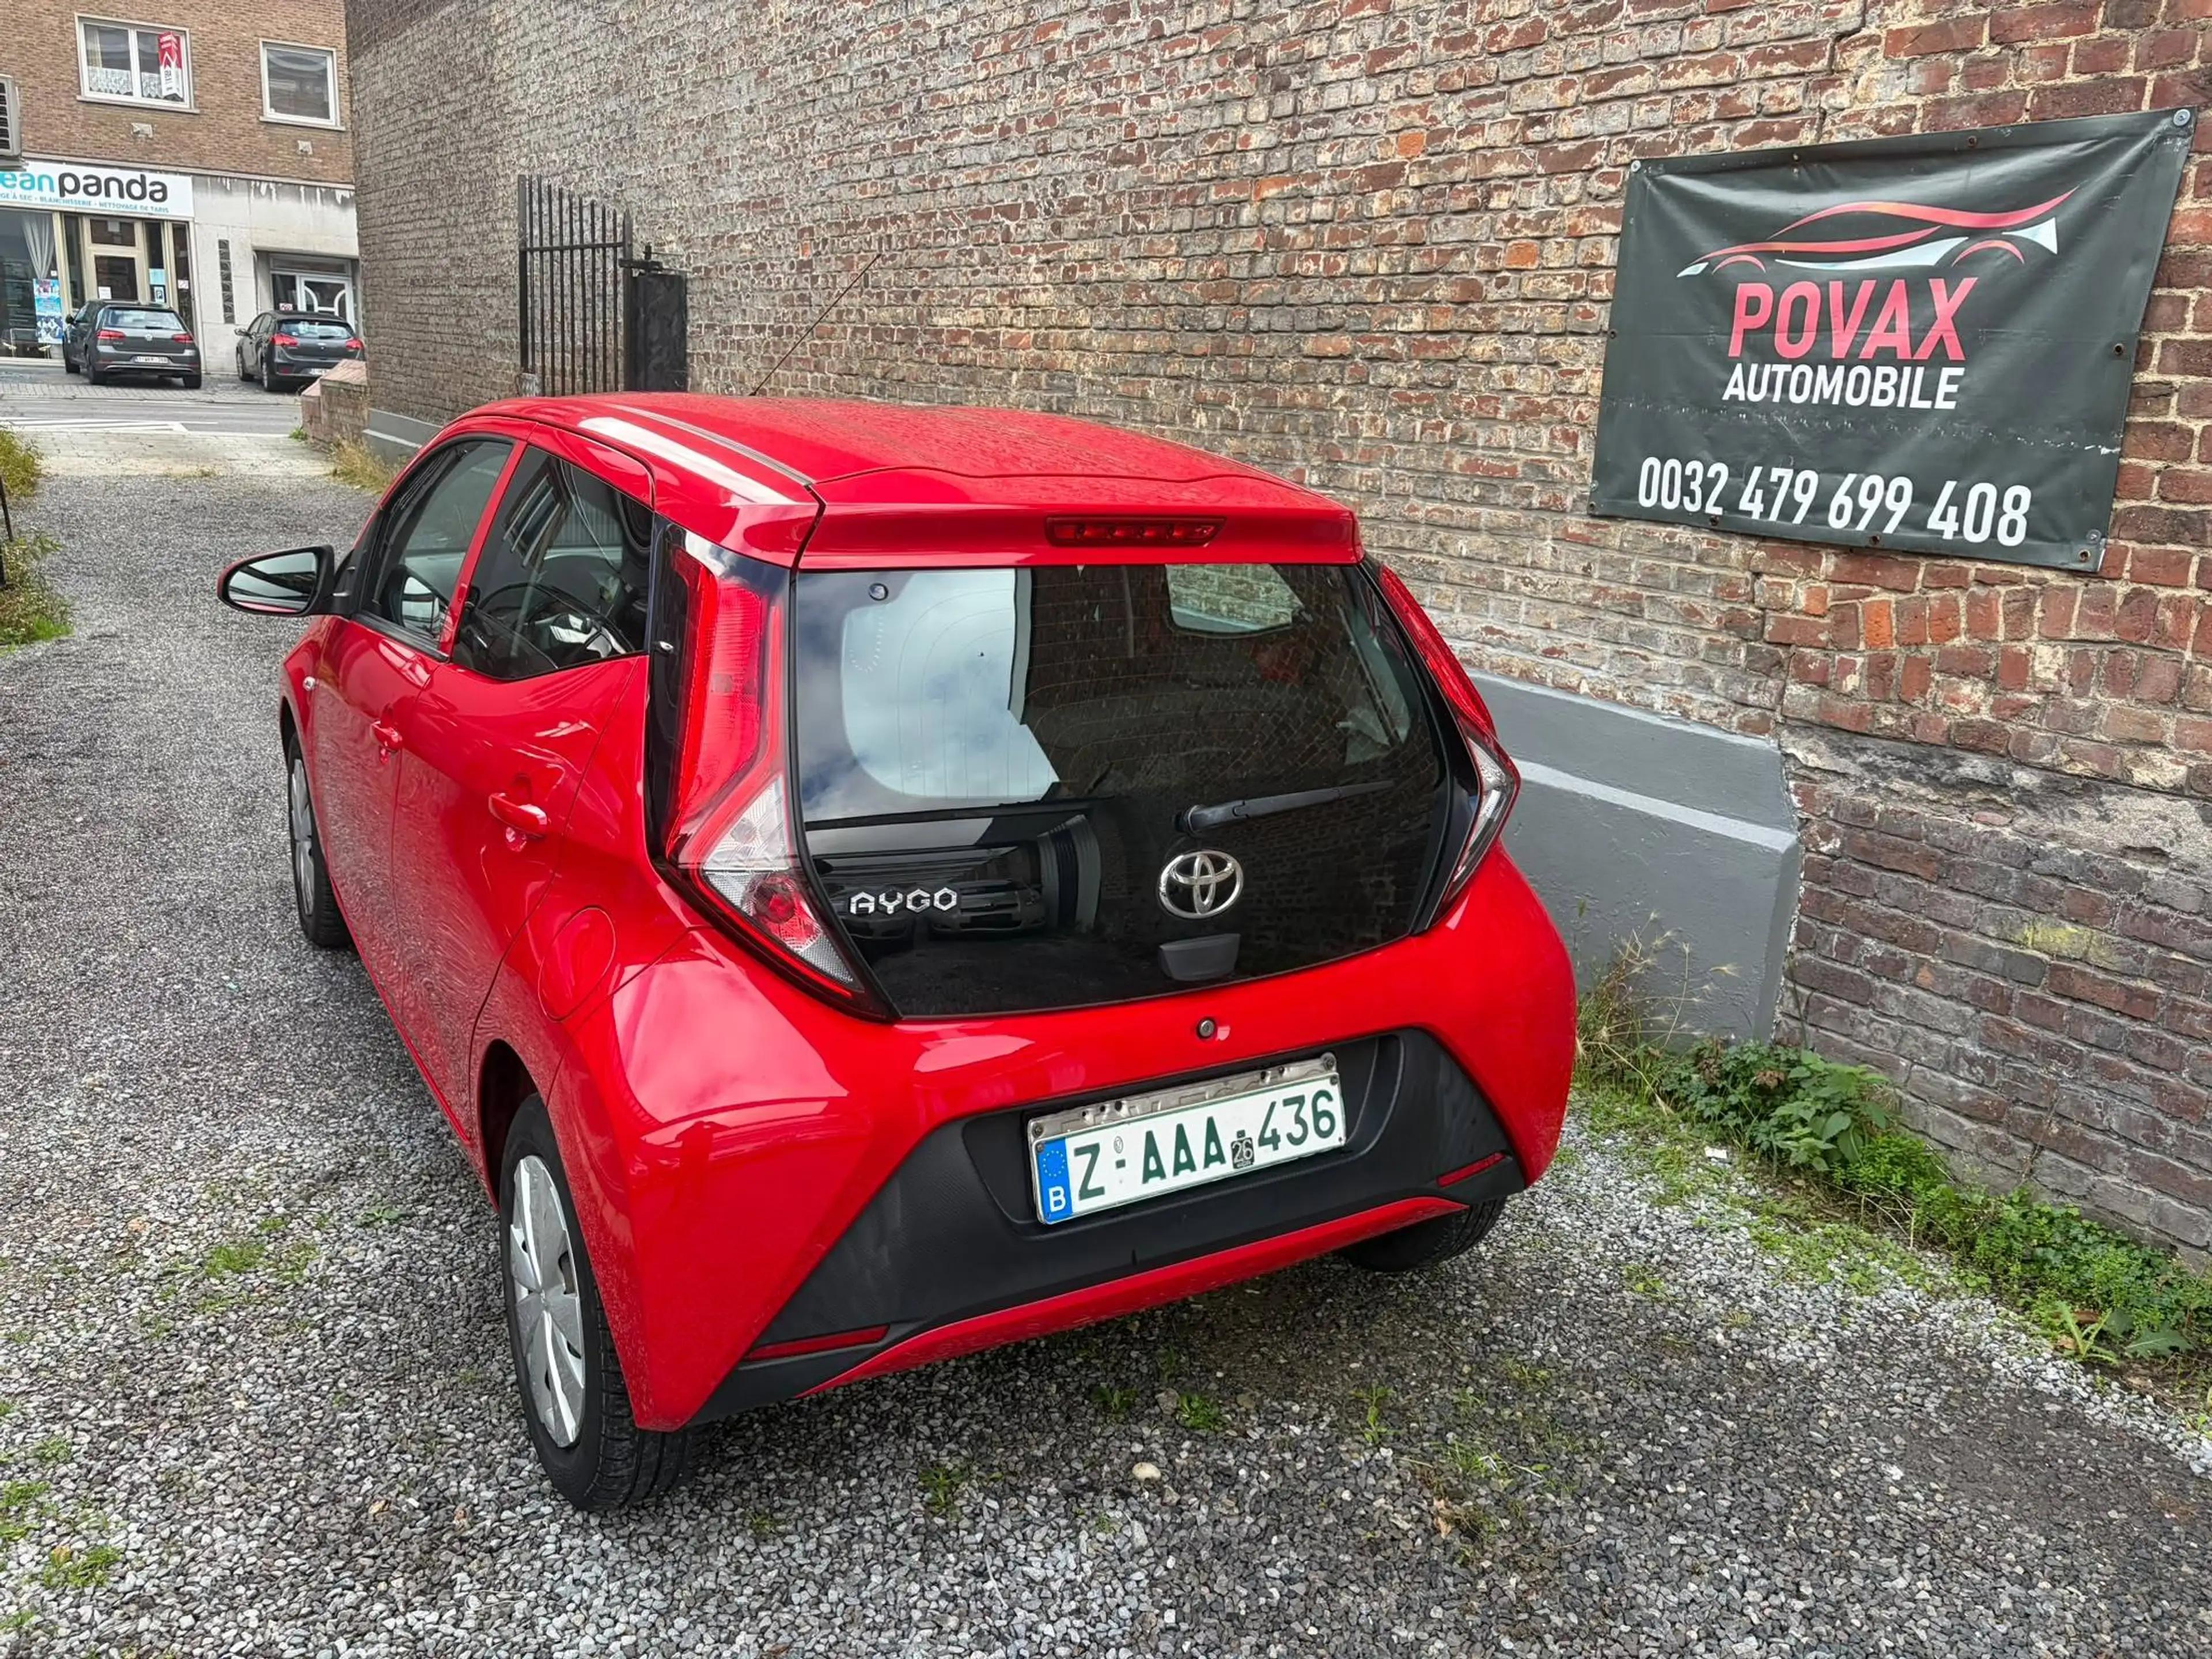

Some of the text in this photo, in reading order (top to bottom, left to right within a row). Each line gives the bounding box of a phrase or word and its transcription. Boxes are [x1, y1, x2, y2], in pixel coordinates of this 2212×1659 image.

[1728, 277, 1978, 361] POVAX
[1722, 362, 1965, 410] AUTOMOBILE
[1637, 456, 2033, 547] 0032 479 699 408
[850, 887, 957, 915] AYGO
[1232, 1139, 1253, 1164] 26
[1049, 1186, 1066, 1211] B
